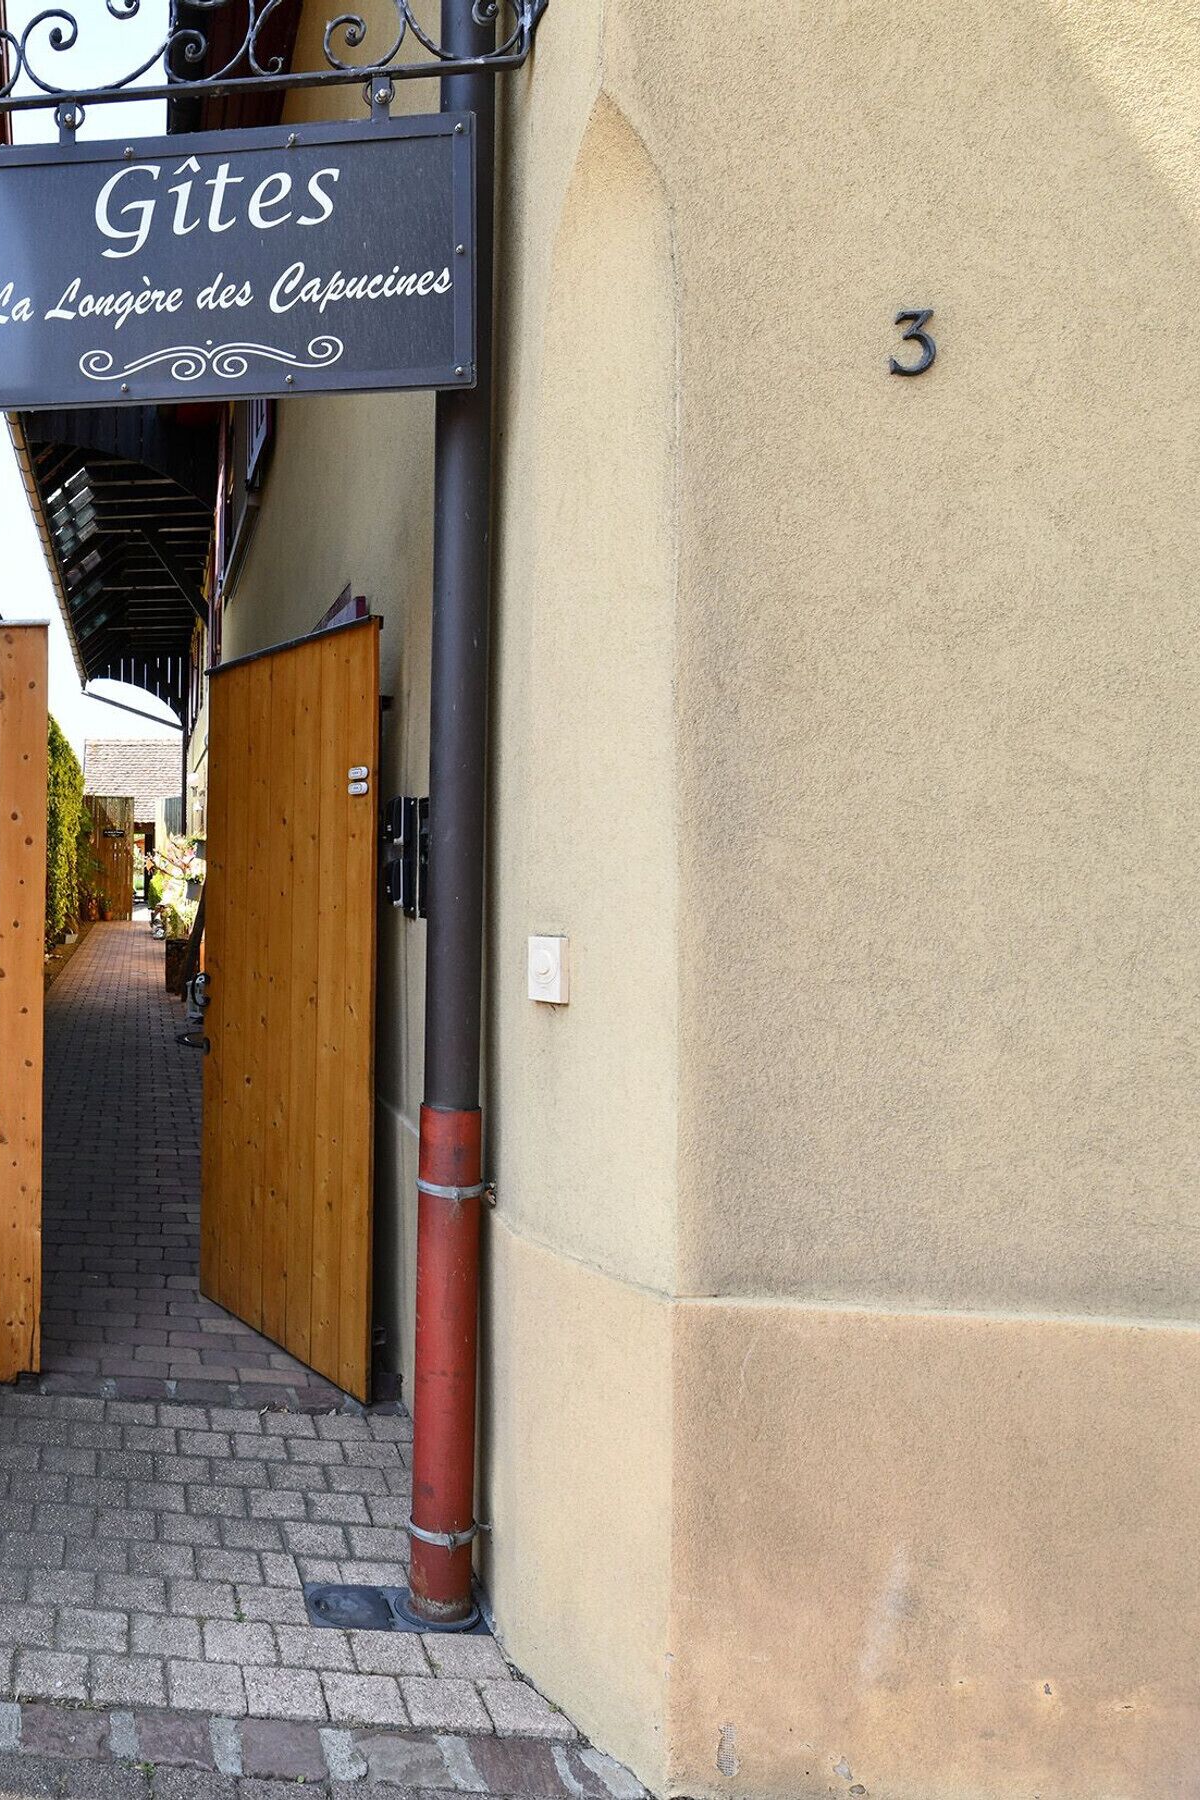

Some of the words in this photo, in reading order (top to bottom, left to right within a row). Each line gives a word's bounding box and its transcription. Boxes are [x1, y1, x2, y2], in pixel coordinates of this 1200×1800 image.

[95, 155, 340, 259] Gîtes
[44, 275, 184, 330] Longère
[196, 272, 254, 310] des
[269, 261, 453, 314] Capucines
[889, 308, 937, 377] 3
